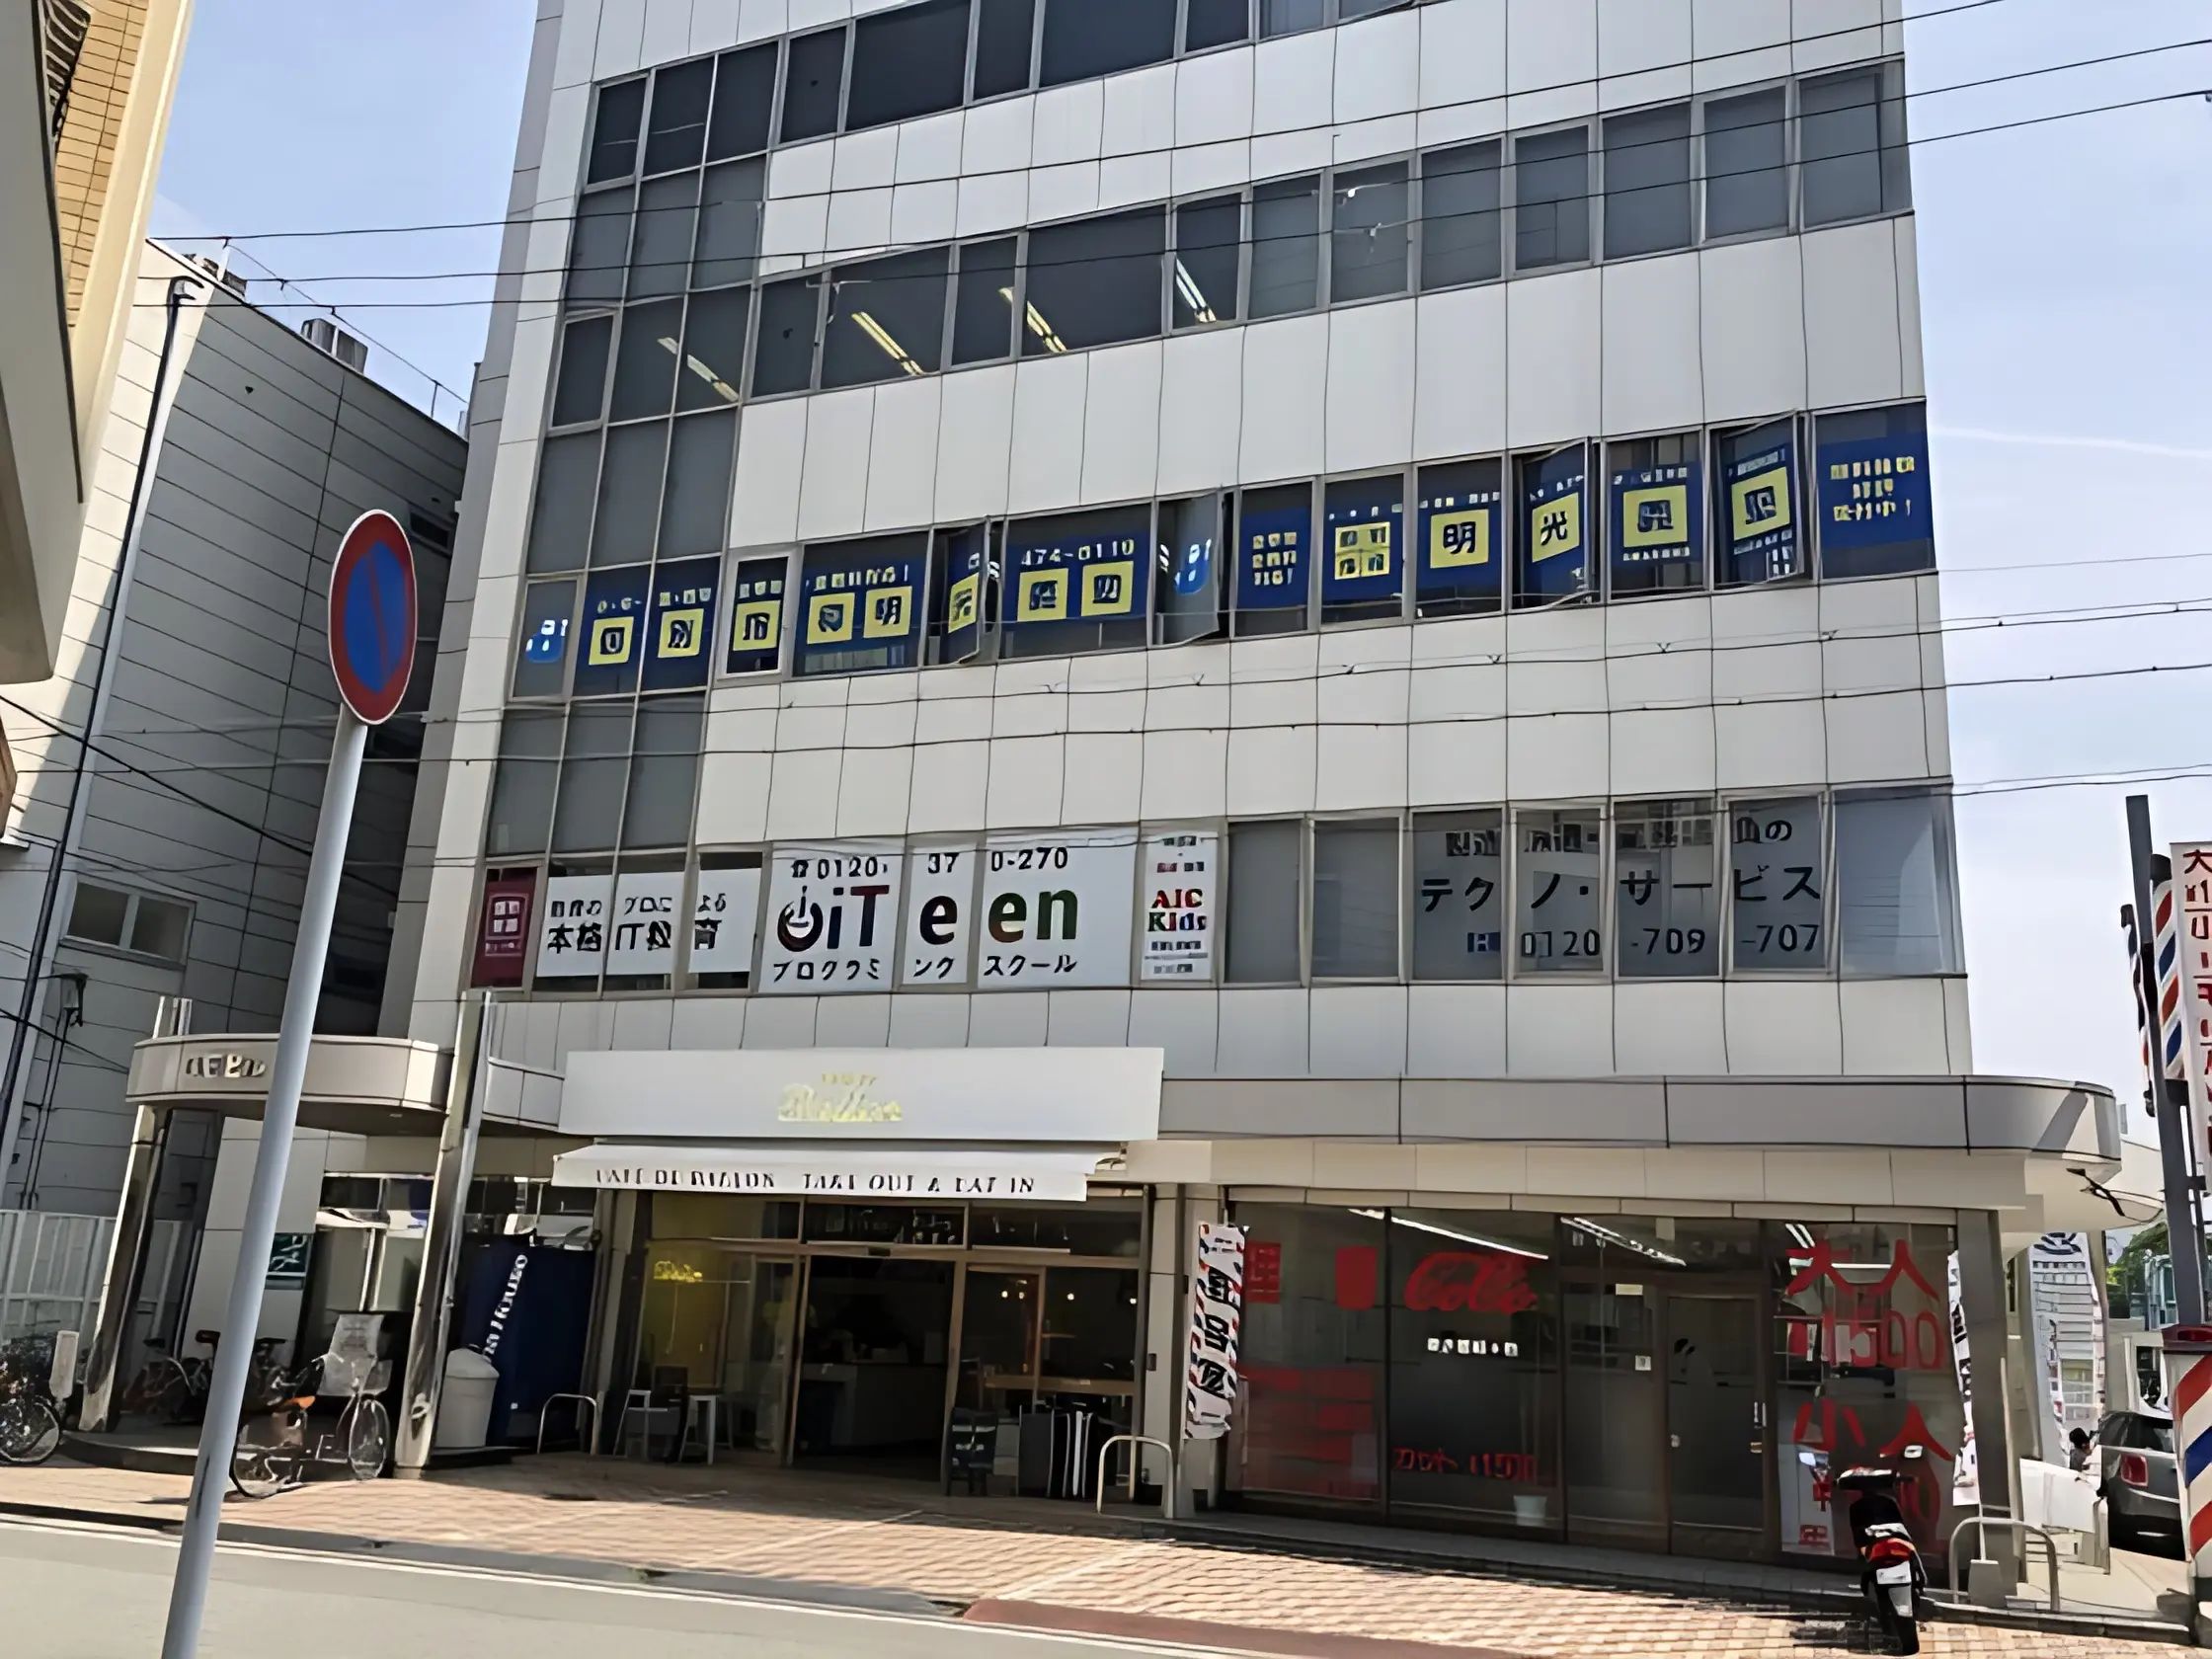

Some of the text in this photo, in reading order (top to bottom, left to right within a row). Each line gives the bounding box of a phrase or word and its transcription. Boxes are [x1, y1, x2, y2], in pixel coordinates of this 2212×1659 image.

[1010, 1177, 1035, 1194] IN
[1785, 1238, 1940, 1302] 大人
[1792, 1397, 1955, 1462] 小人
